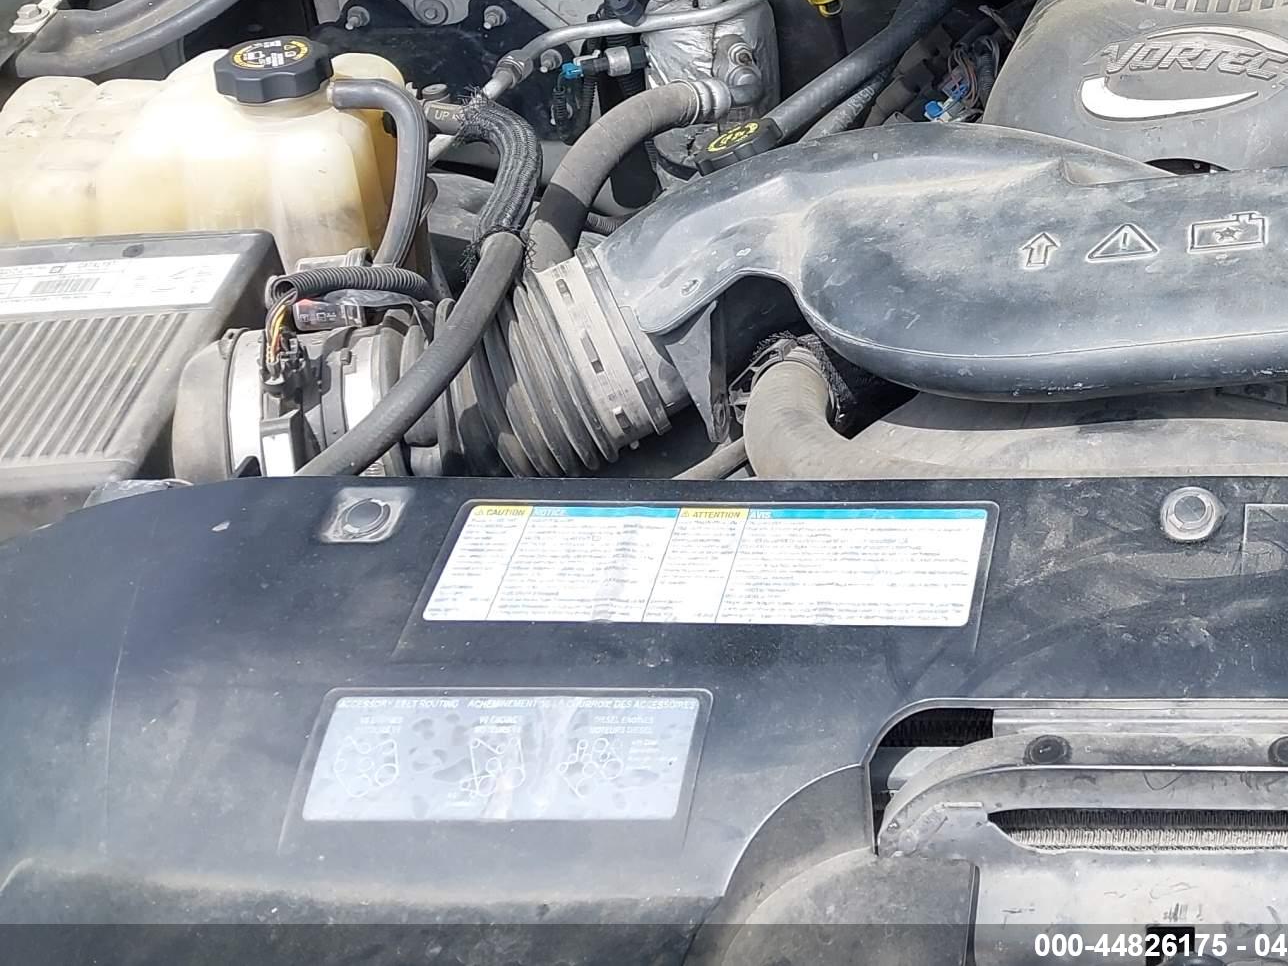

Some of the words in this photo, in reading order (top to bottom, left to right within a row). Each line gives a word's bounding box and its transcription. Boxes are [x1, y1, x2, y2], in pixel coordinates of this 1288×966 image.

[434, 109, 450, 121] UP
[486, 508, 526, 516] CAUTION
[693, 511, 741, 519] ATTENTION
